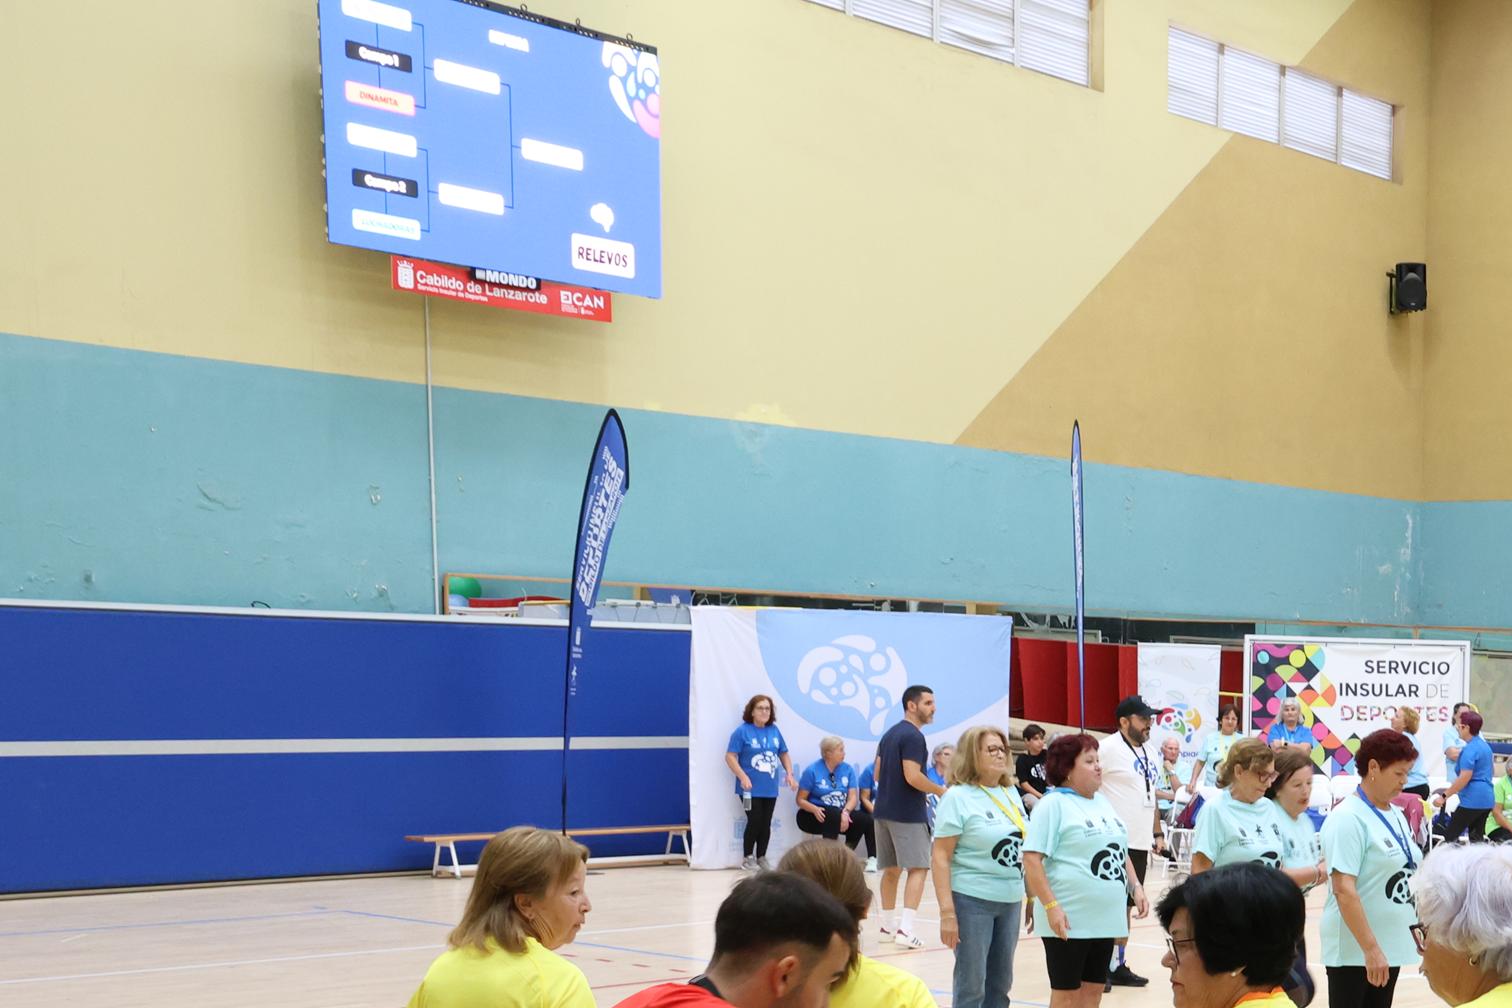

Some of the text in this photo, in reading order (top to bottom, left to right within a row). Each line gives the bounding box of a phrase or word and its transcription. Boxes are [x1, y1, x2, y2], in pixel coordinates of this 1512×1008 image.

[359, 90, 399, 107] DINAMITA
[577, 246, 628, 268] RELEVOS
[416, 270, 548, 305] Cabildo de Lanzarote
[486, 269, 537, 290] MONDO
[1364, 659, 1450, 675] SERVICIO
[1339, 682, 1449, 699] INSULAR DE
[1340, 705, 1449, 722] DEPOTES
